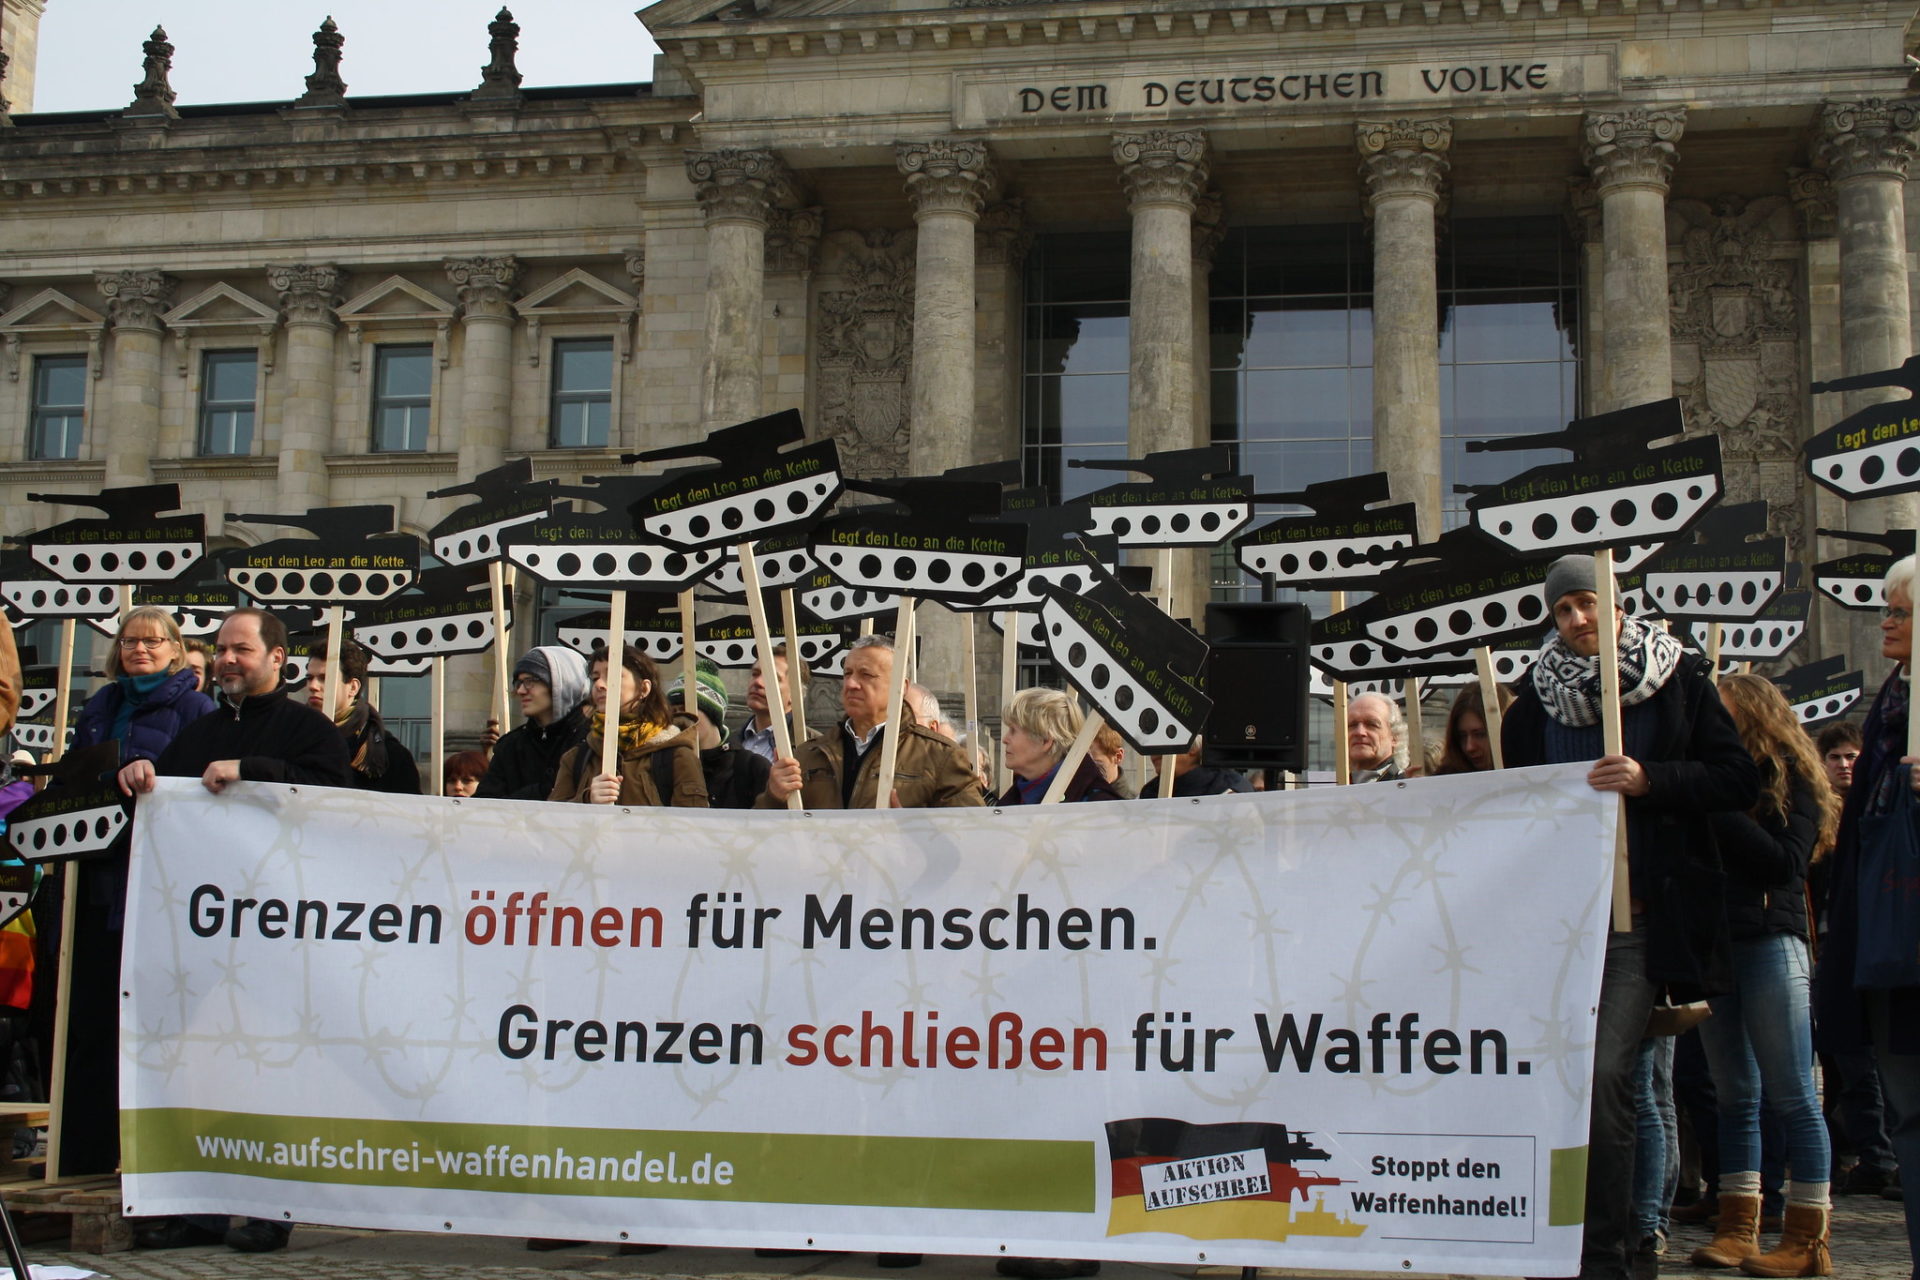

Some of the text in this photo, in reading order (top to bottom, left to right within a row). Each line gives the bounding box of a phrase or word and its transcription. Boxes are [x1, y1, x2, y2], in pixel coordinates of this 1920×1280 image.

[1018, 63, 1548, 113] DEM DEUTSCHEN VOLKE
[1836, 417, 1920, 449] Legt den Le
[654, 458, 820, 512] Legt den Leo an die Kette
[1502, 455, 1704, 501] Legt den Leo an die Kette
[832, 529, 1007, 553] Legt den Leo an die Kette
[1258, 519, 1405, 544] Legt den Leo an die Kette
[248, 555, 404, 569] Legt den Leo an die Kette
[1065, 549, 1097, 561] Kee
[812, 573, 831, 588] Legt
[1385, 563, 1548, 611] Legt den Leo an die Ket
[1071, 600, 1091, 621] egt
[1092, 617, 1110, 640] den
[1110, 634, 1130, 659] Leo
[1130, 657, 1145, 673] an
[1146, 670, 1162, 690] die
[1164, 682, 1193, 718] Kette
[188, 883, 1157, 950] Grenzen öffnen für Menschen.
[498, 1003, 1532, 1075] Grenzen schließen für Waffen.
[195, 1135, 734, 1186] www.aufschrei-waffenhandel.de
[1163, 1154, 1245, 1183] AKTION
[1371, 1155, 1501, 1183] Stoppt den
[1147, 1174, 1269, 1209] AUFSCHREI
[1350, 1191, 1527, 1218] Waffenhandel!
